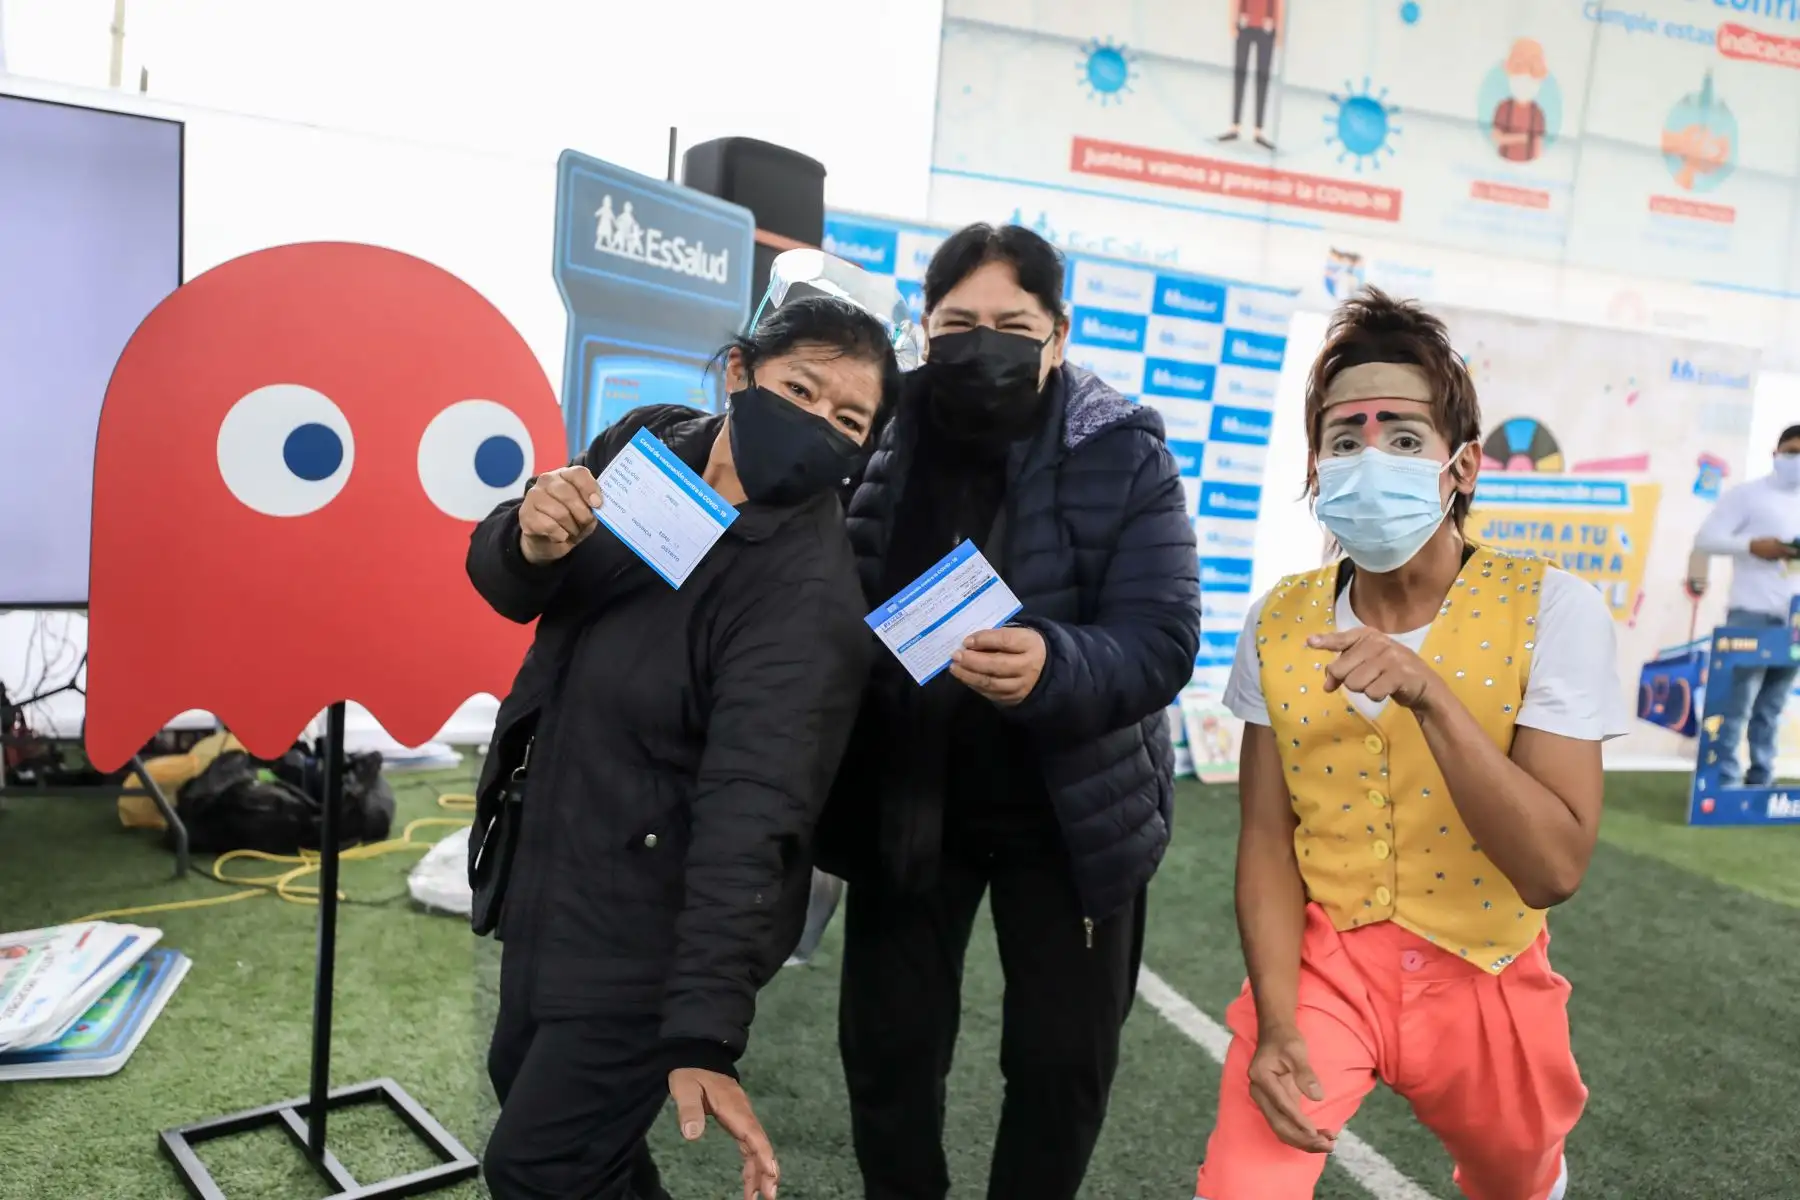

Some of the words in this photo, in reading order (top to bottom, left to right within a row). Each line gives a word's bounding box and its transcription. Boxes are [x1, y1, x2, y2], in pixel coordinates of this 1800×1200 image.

[1208, 168, 1221, 185] a
[1294, 180, 1314, 199] la
[644, 228, 728, 284] EsSalud
[652, 449, 661, 458] de
[701, 494, 719, 510] COVID
[1481, 520, 1555, 542] JUNTA
[1560, 524, 1573, 543] A
[1580, 525, 1608, 546] TU
[1610, 554, 1623, 573] A
